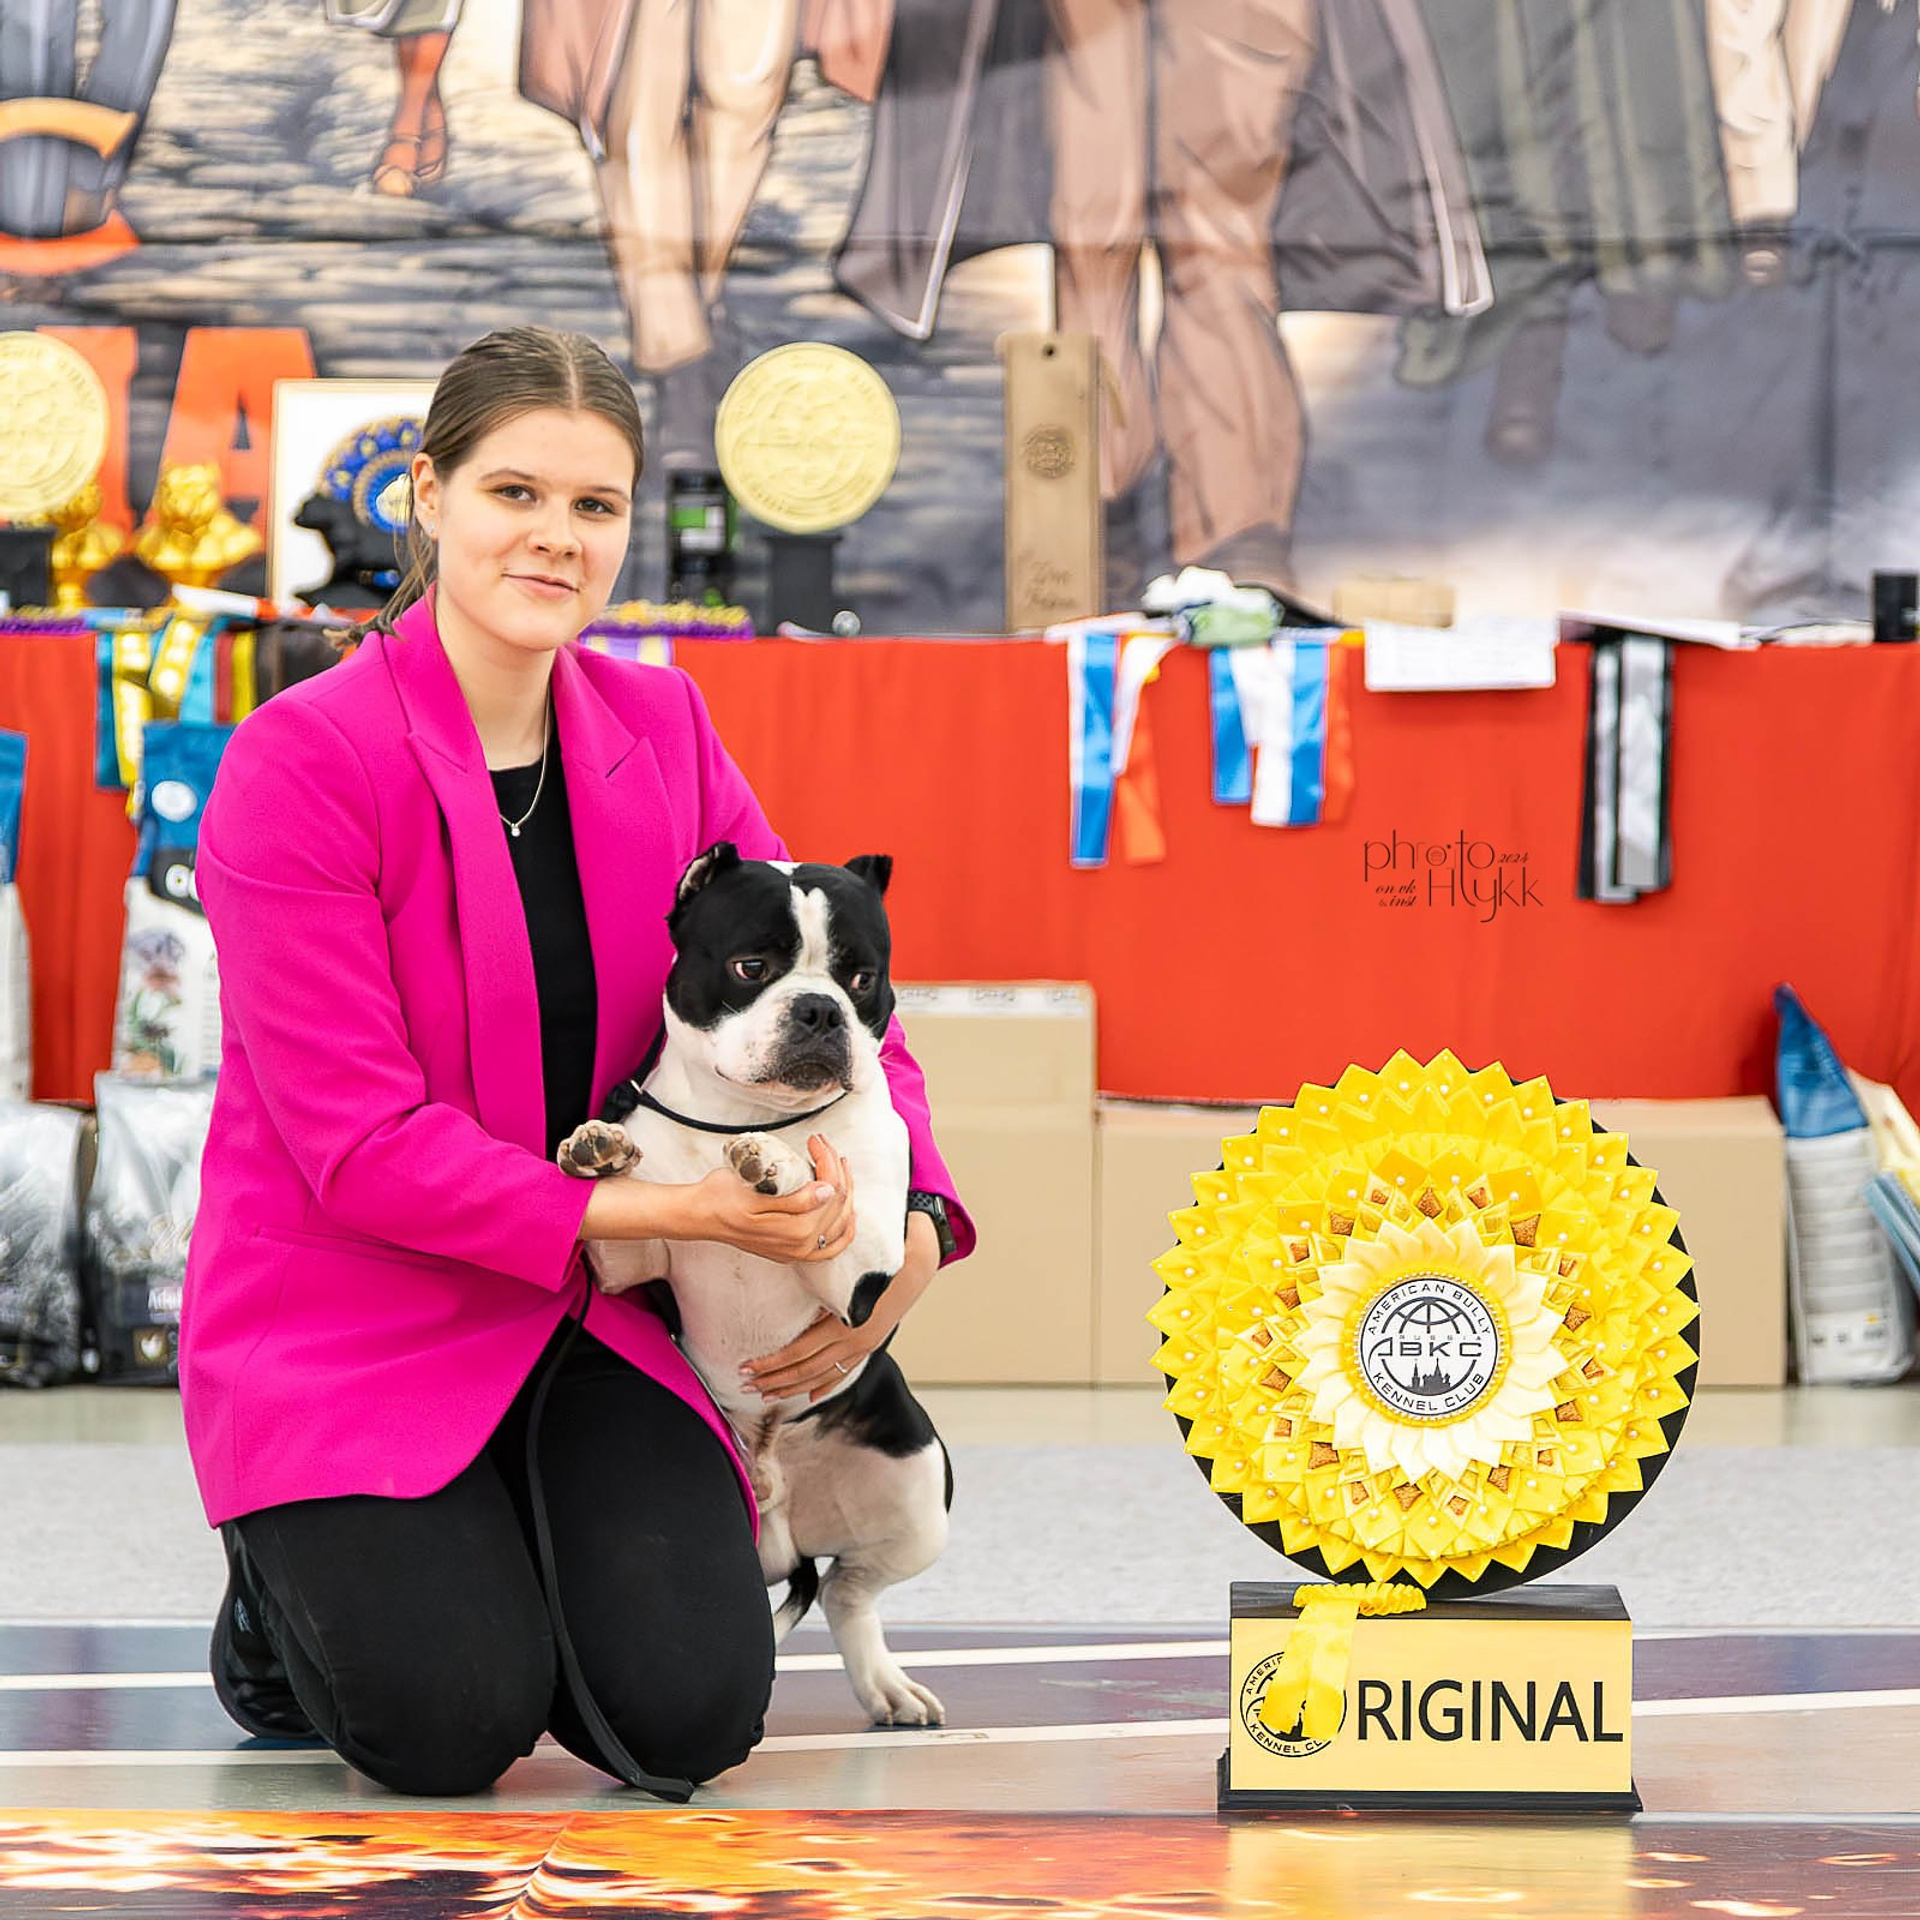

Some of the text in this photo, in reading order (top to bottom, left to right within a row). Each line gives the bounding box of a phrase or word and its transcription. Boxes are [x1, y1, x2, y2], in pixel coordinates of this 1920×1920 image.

[1367, 1283, 1491, 1336] AMERICAN BULLY
[1368, 1336, 1483, 1364] ABKC
[1372, 1372, 1485, 1412] KENNEL CLUB
[1249, 1722, 1323, 1754] KENNEL CL
